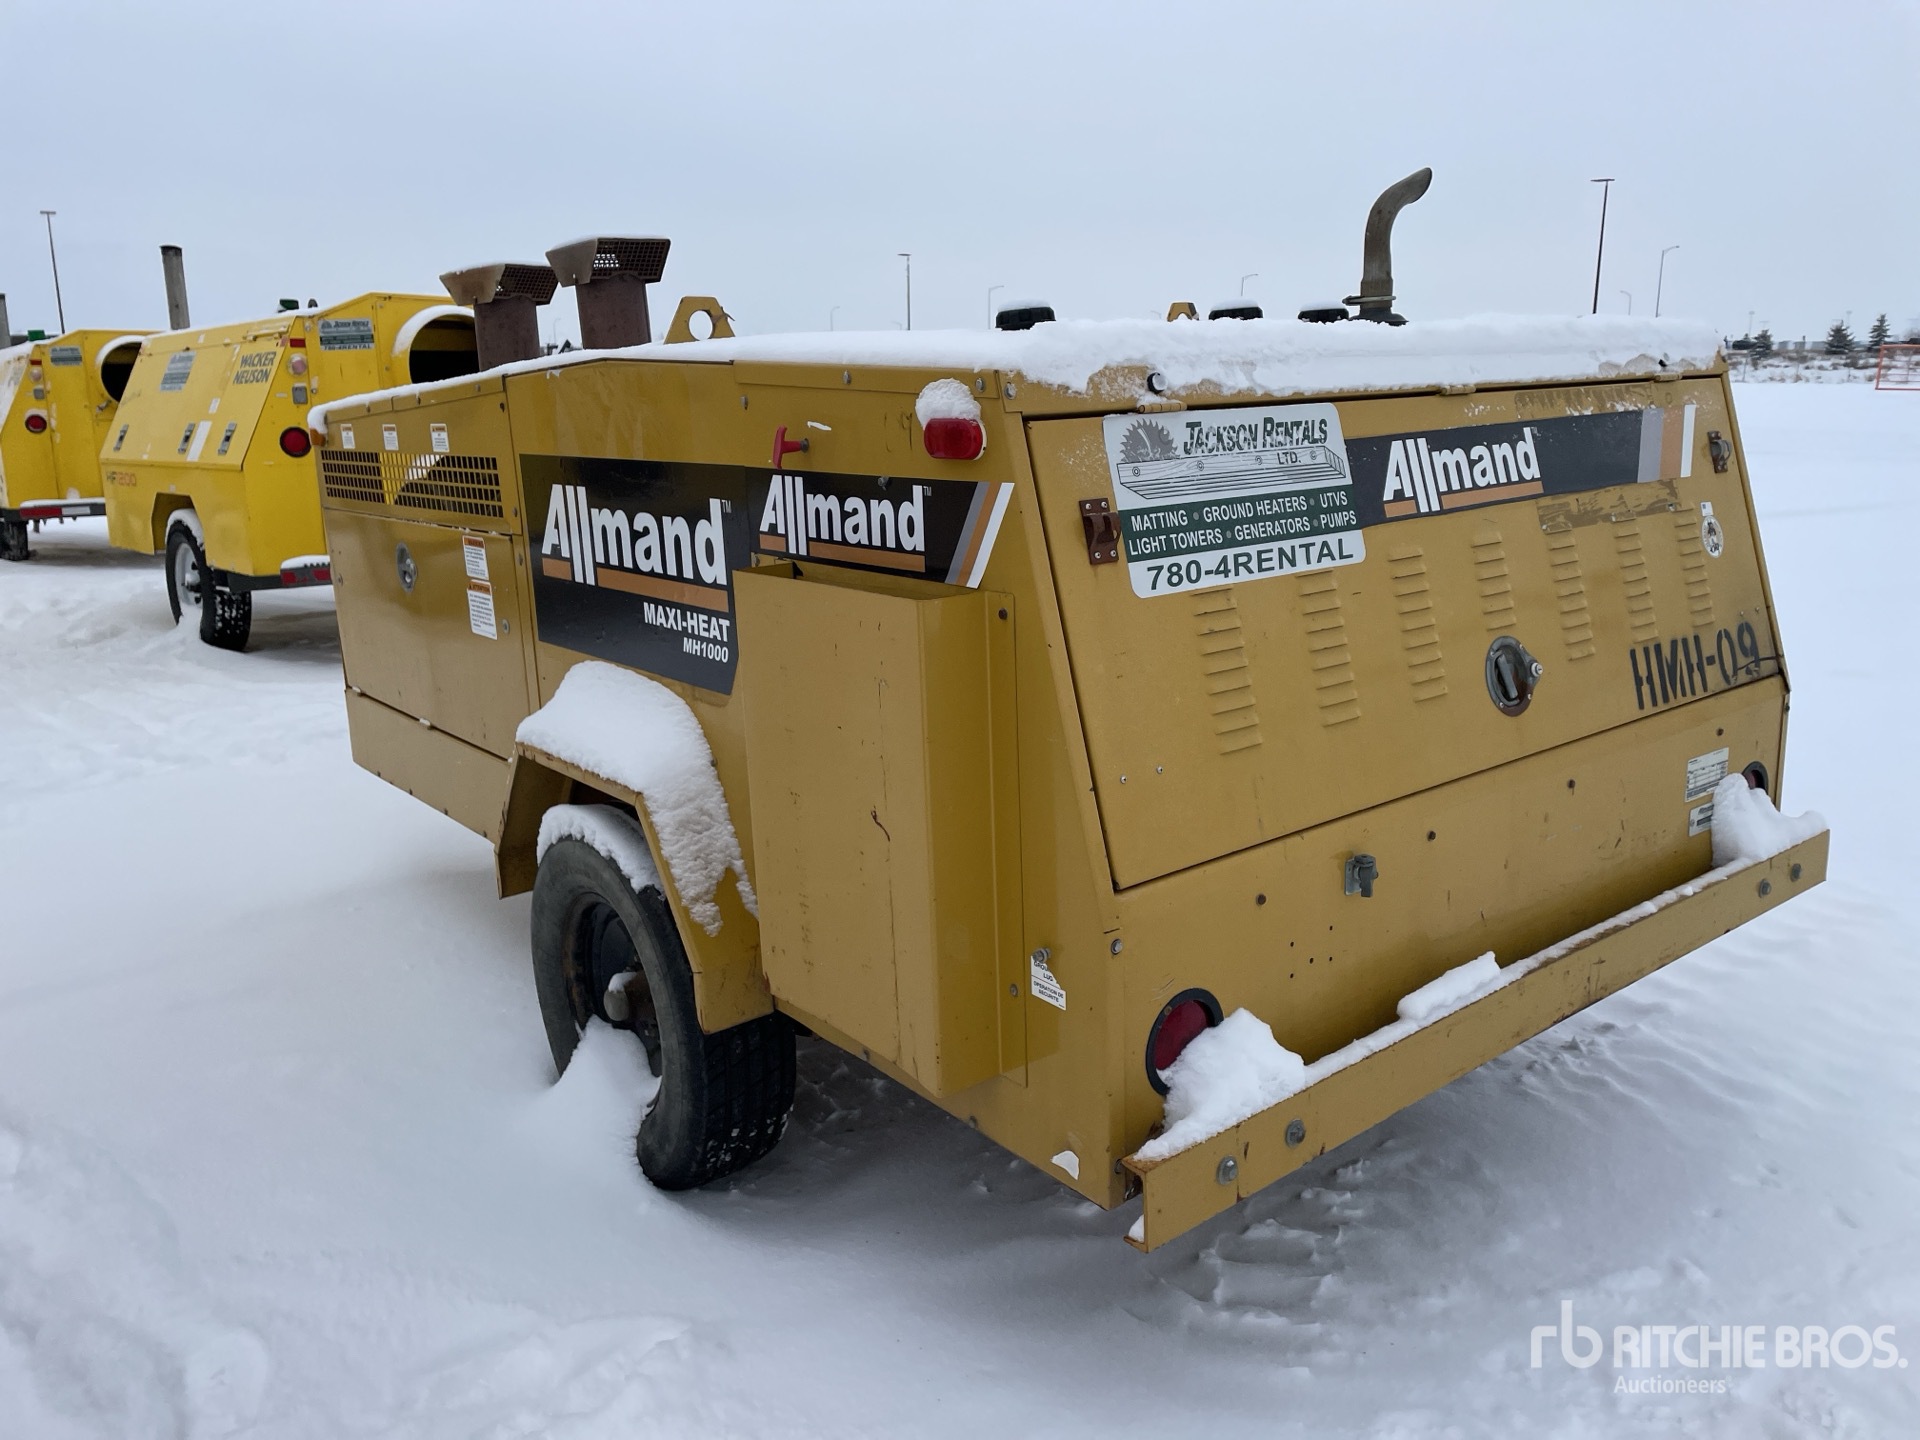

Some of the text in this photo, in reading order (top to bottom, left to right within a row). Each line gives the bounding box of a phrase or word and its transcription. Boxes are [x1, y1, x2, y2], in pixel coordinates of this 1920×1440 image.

[233, 368, 272, 385] NEUSON
[240, 351, 277, 368] WACKER
[1184, 417, 1328, 455] JACKSON RENTALS
[1277, 452, 1302, 465] LTD.
[1383, 426, 1541, 513] Allmand
[759, 475, 925, 555] Allmand
[1131, 491, 1348, 531] MATTING GROUND HEATERS UTVS
[541, 484, 728, 586] Allmand
[1129, 510, 1357, 556] LIGHT TOWERS GENERATORS PUMPS
[1147, 538, 1354, 591] 780-4RENTAL
[643, 601, 730, 642] MAXI-HEAT
[683, 636, 729, 663] MH1000
[1630, 621, 1761, 710] HMH-09
